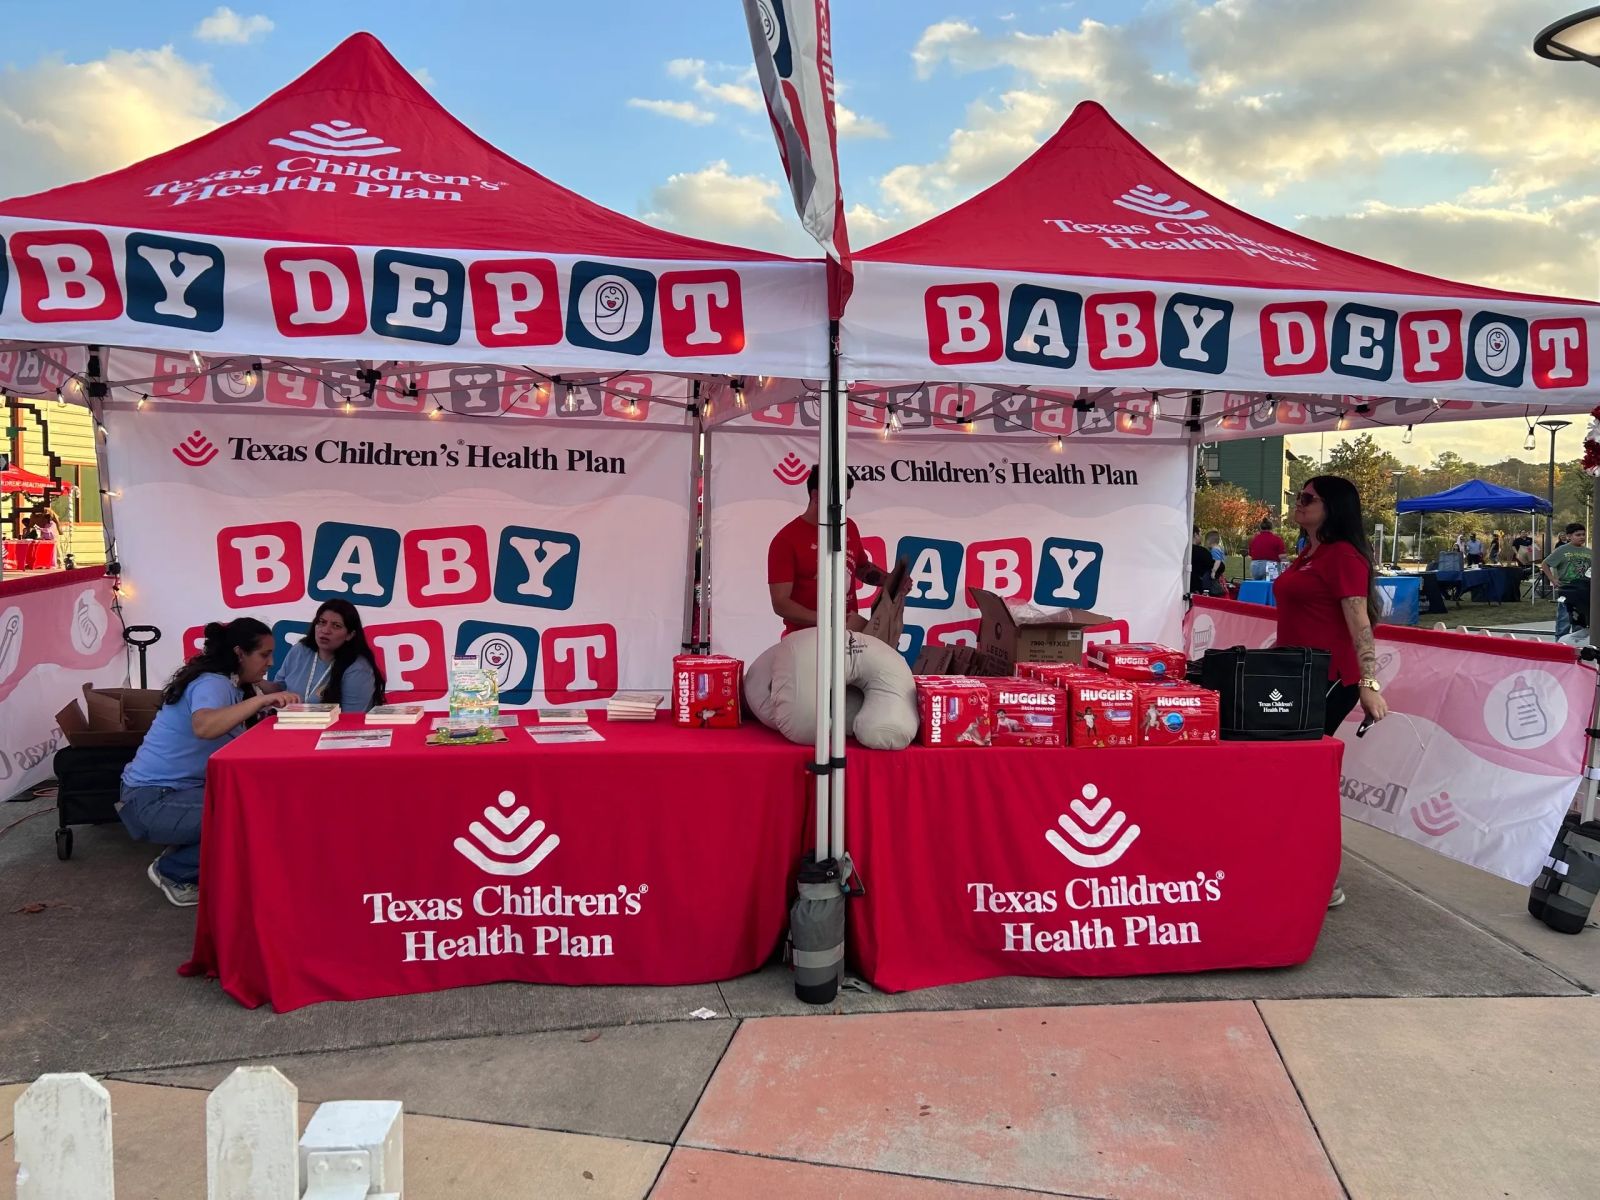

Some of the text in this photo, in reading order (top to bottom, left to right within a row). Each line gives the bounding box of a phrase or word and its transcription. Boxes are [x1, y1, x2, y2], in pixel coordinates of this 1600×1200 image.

[144, 165, 263, 197] Texas
[168, 176, 463, 207] Health Plan
[1043, 219, 1151, 236] Texas
[1099, 236, 1237, 251] Health
[26, 243, 730, 346] BY DEPOT
[936, 294, 1582, 380] BABY DEPOT
[228, 436, 307, 462] Texas
[465, 444, 559, 471] Health
[566, 448, 627, 475] Plan
[847, 465, 886, 482] xas
[1011, 462, 1086, 485] Health
[1089, 463, 1139, 485] Plan
[230, 534, 571, 599] BABY
[1114, 656, 1149, 665] HUGGIES
[679, 672, 690, 722] HUGGIES
[999, 692, 1056, 705] HUGGIES
[1080, 689, 1133, 701] HUGGIES
[1157, 697, 1200, 707] HUGGIES
[931, 695, 942, 743] HUGGIES
[363, 892, 463, 924] Texas
[967, 883, 1058, 913] Texas
[401, 925, 615, 962] Health Plan
[1001, 915, 1202, 953] Health Plan
